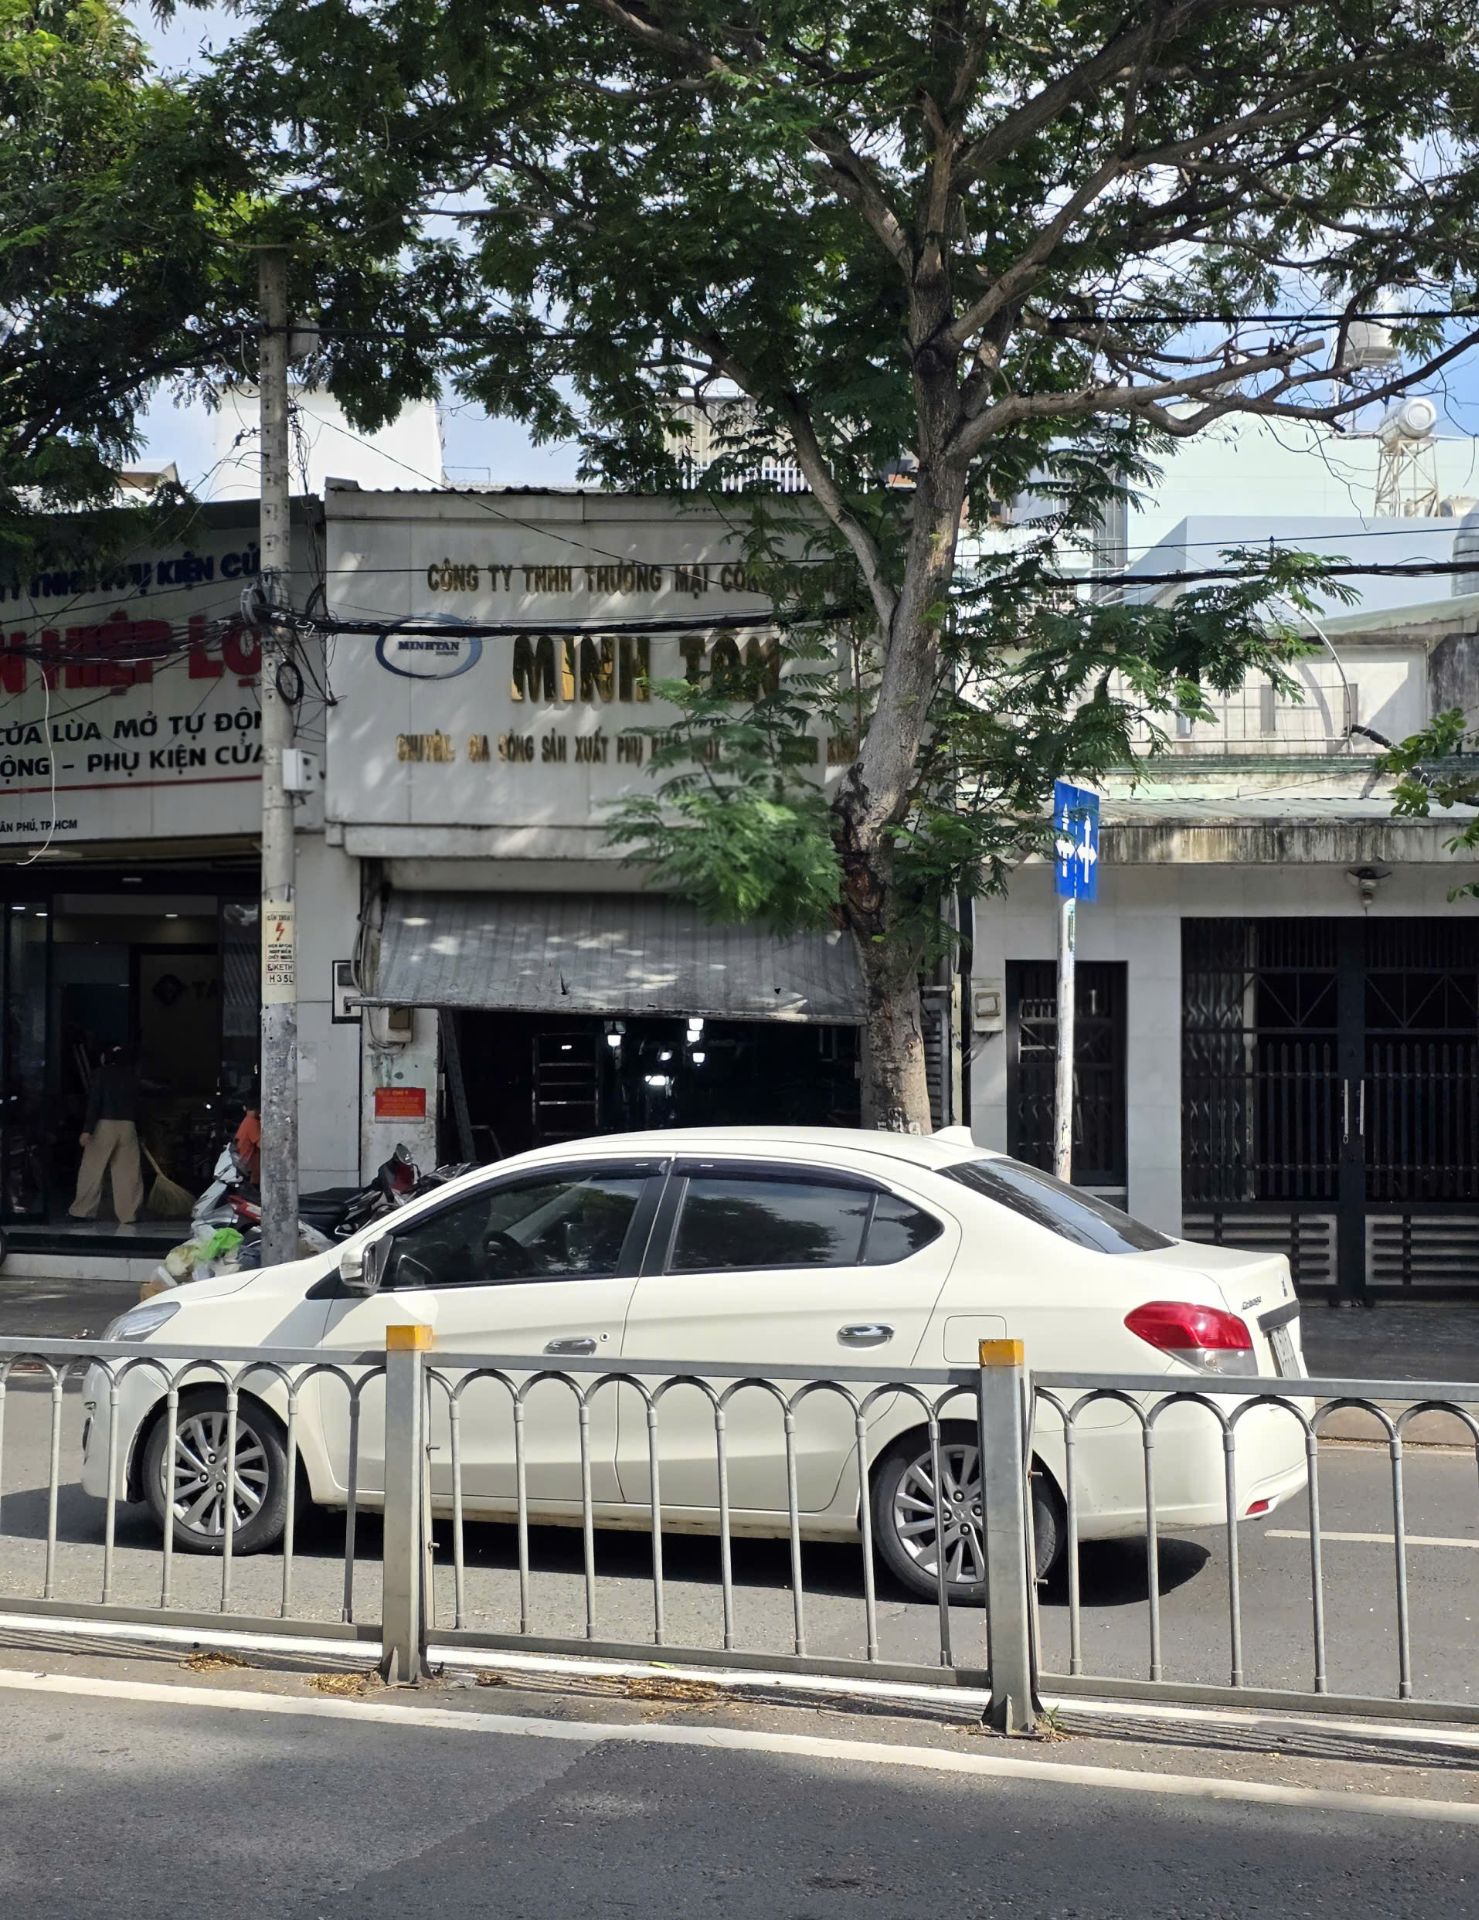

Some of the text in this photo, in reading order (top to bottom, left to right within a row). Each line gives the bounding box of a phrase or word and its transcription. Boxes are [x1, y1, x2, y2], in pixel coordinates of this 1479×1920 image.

[427, 558, 480, 592] CÔNG
[489, 565, 513, 592] TY
[522, 565, 572, 592] TNHH
[675, 565, 709, 599] MẠI
[511, 635, 651, 702] MINH
[53, 719, 102, 742] LÙA
[113, 711, 158, 739] MỞ
[169, 712, 207, 741] TỰ
[575, 726, 609, 764] XUẤT
[88, 751, 140, 778] PHỤ
[150, 745, 206, 775] KIỆN
